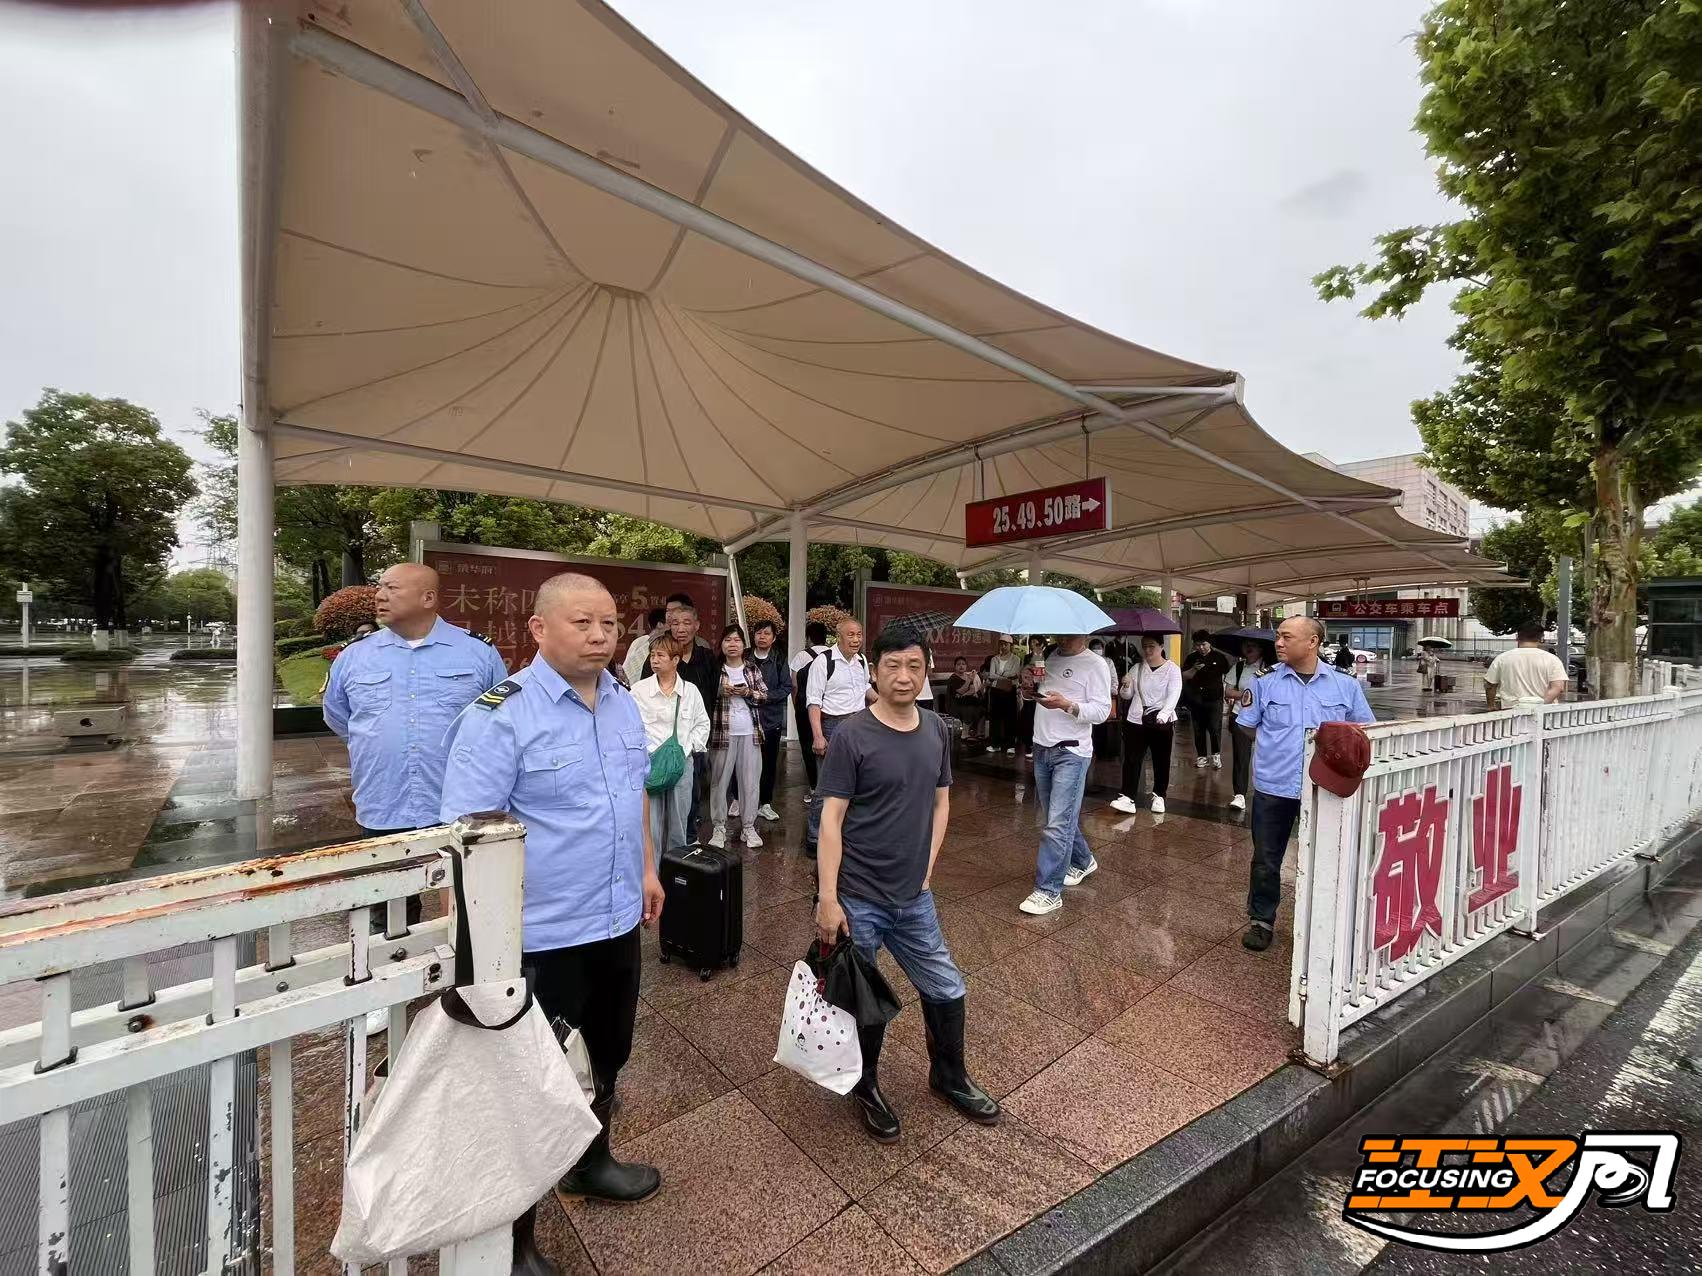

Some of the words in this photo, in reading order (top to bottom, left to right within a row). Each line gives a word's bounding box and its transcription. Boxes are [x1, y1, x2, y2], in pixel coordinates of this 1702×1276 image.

[1353, 602, 1448, 616] 公交车乘车点
[1372, 762, 1522, 962] 敬业
